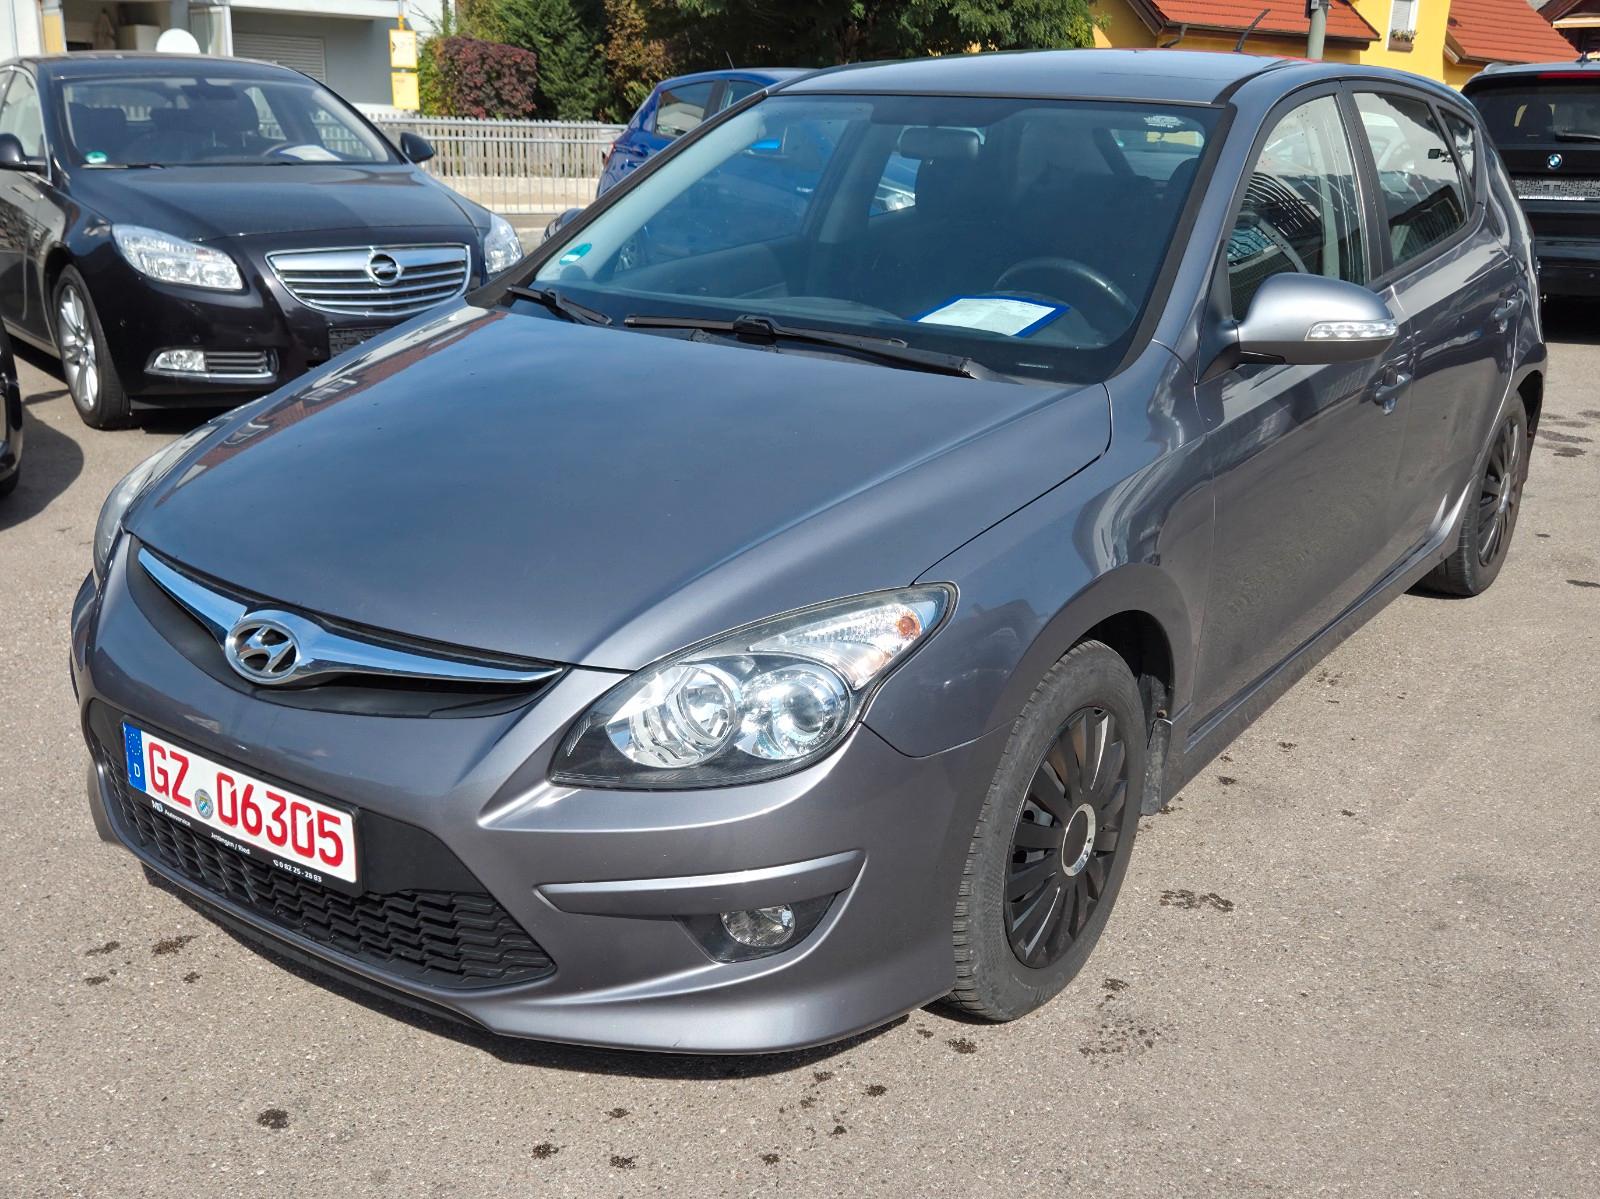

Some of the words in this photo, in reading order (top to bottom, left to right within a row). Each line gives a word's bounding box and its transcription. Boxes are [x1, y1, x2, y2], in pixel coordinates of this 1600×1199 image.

[133, 763, 141, 778] D
[149, 741, 192, 808] GZ
[216, 771, 344, 867] 06305
